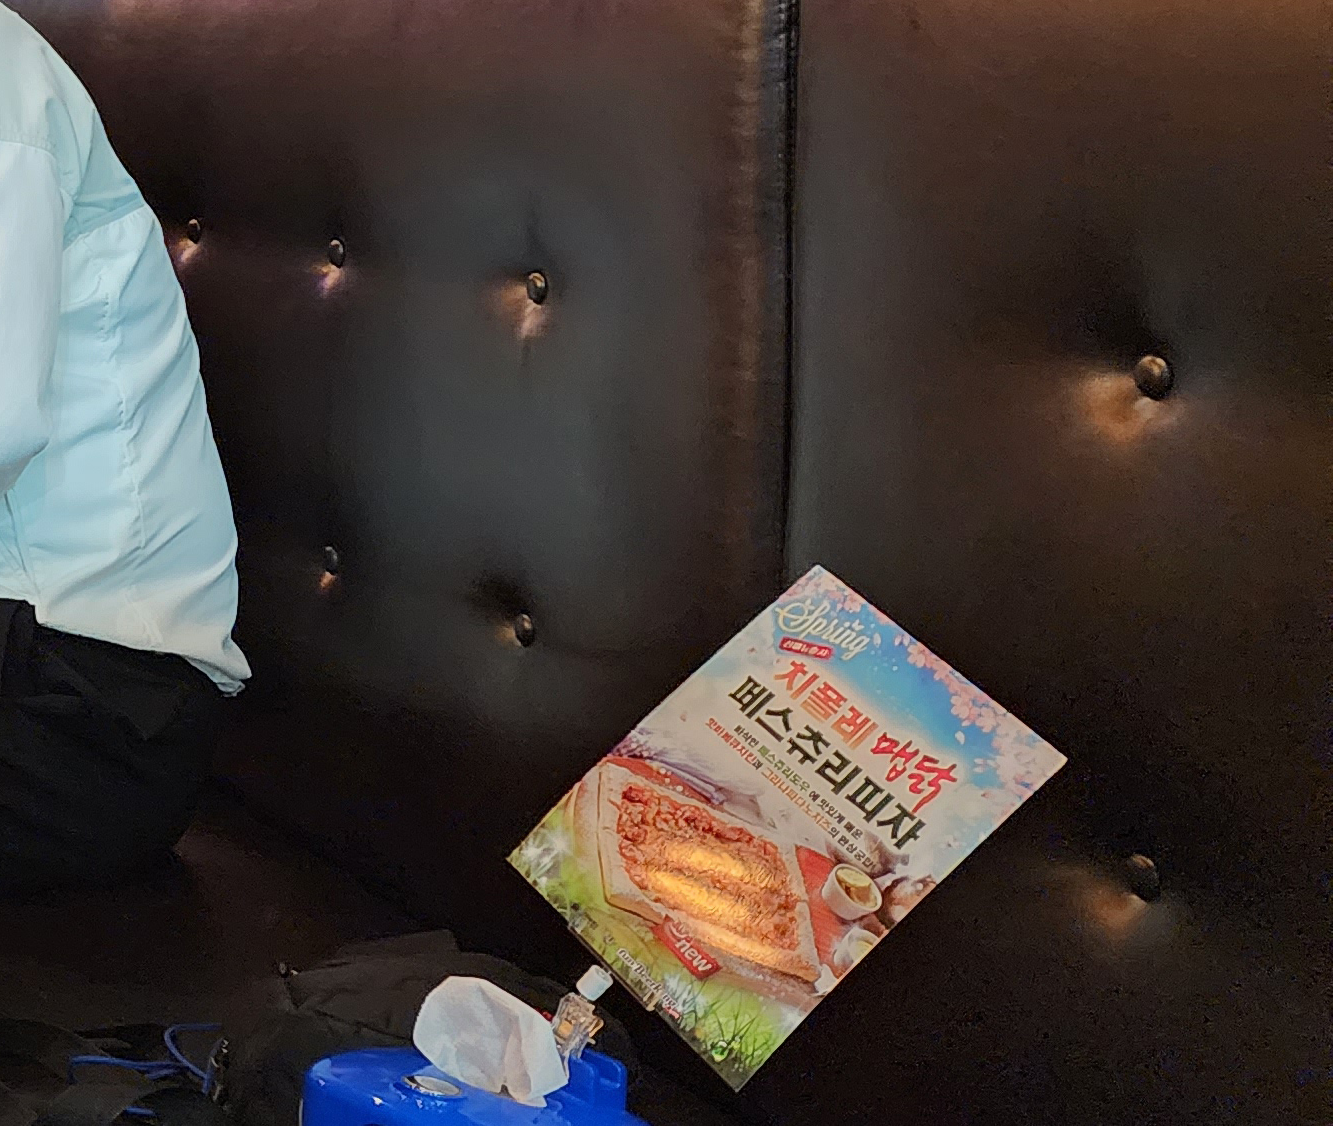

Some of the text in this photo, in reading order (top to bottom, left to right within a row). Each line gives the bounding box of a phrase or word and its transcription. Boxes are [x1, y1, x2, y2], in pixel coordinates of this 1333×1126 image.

[774, 599, 870, 661] Spring
[728, 675, 927, 850] 페스츄리피자
[774, 660, 958, 815] 치폴레 맵닭
[675, 939, 712, 972] new
